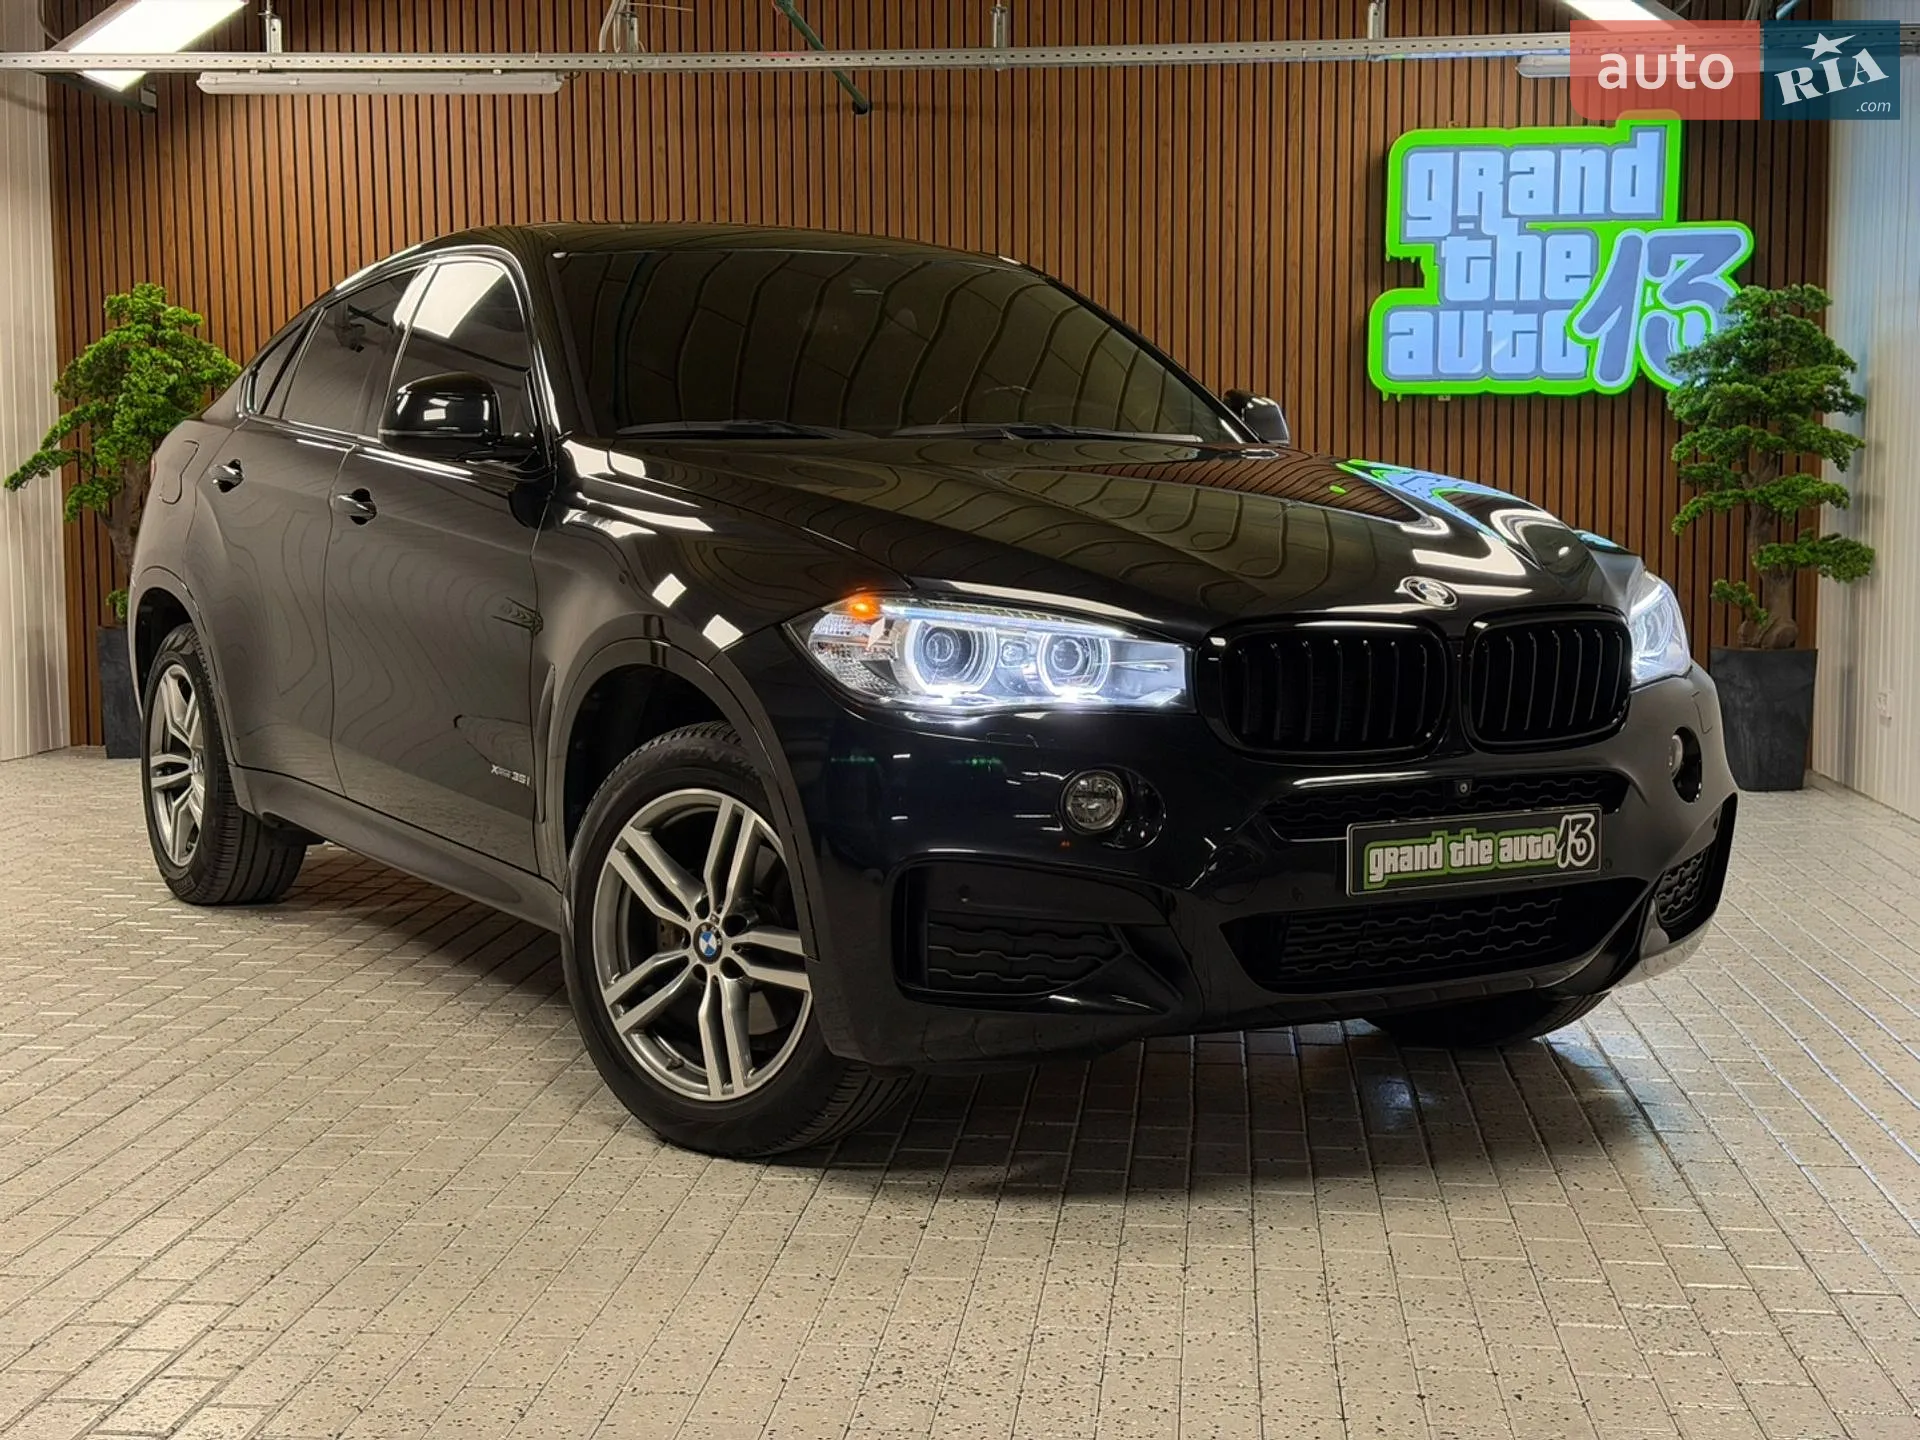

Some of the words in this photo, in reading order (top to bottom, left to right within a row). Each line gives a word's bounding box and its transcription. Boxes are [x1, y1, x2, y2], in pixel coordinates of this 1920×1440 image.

[1440, 217, 1595, 302] the
[1449, 834, 1494, 867] the
[1499, 832, 1557, 863] auto
